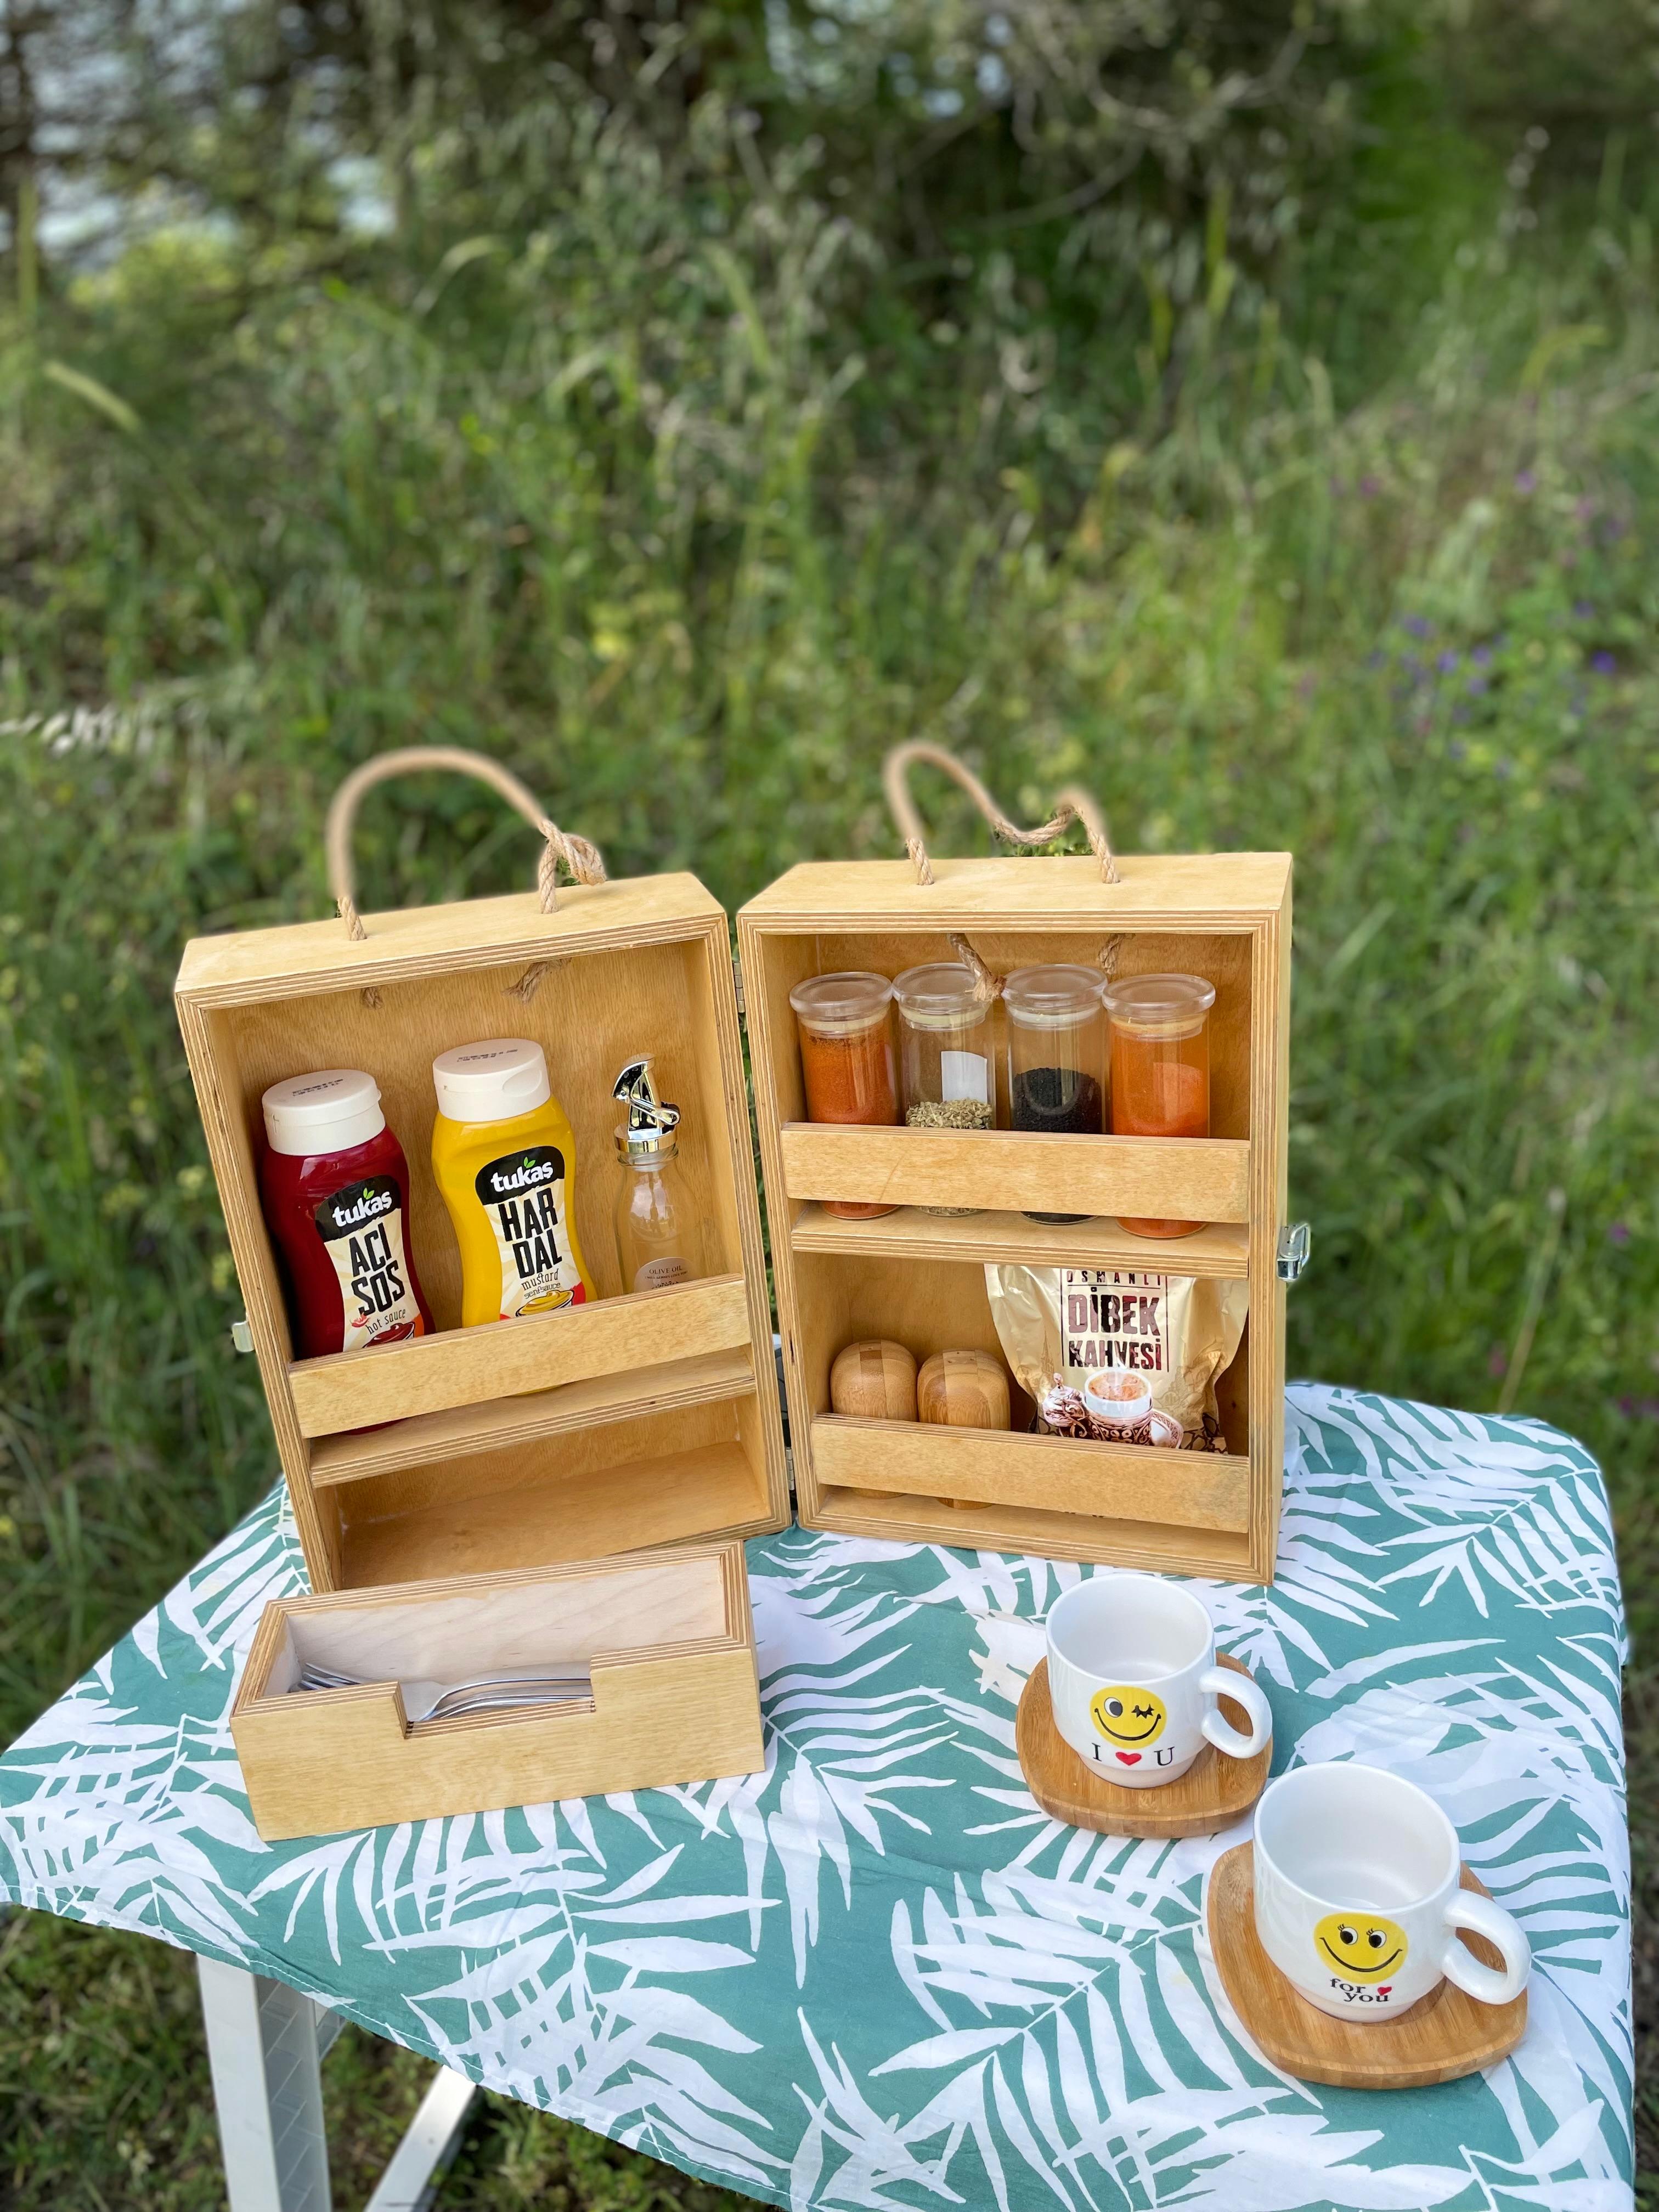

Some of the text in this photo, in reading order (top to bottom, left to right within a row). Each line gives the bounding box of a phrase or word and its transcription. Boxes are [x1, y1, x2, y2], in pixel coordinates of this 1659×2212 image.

[490, 1161, 554, 1192] tukaş
[332, 1191, 392, 1227] tukaş
[498, 1187, 558, 1242] HAR
[349, 1222, 392, 1277] ACI
[512, 1228, 562, 1279] DAL
[351, 1260, 405, 1317] SOS
[521, 1268, 559, 1290] mustard
[365, 1308, 406, 1334] hot sauce
[1068, 1286, 1160, 1336] DİBEK
[1069, 1338, 1161, 1370] KAHVESİ
[1091, 1742, 1175, 1766] I U
[1330, 1978, 1366, 1994] for
[1344, 1992, 1389, 2002] you
